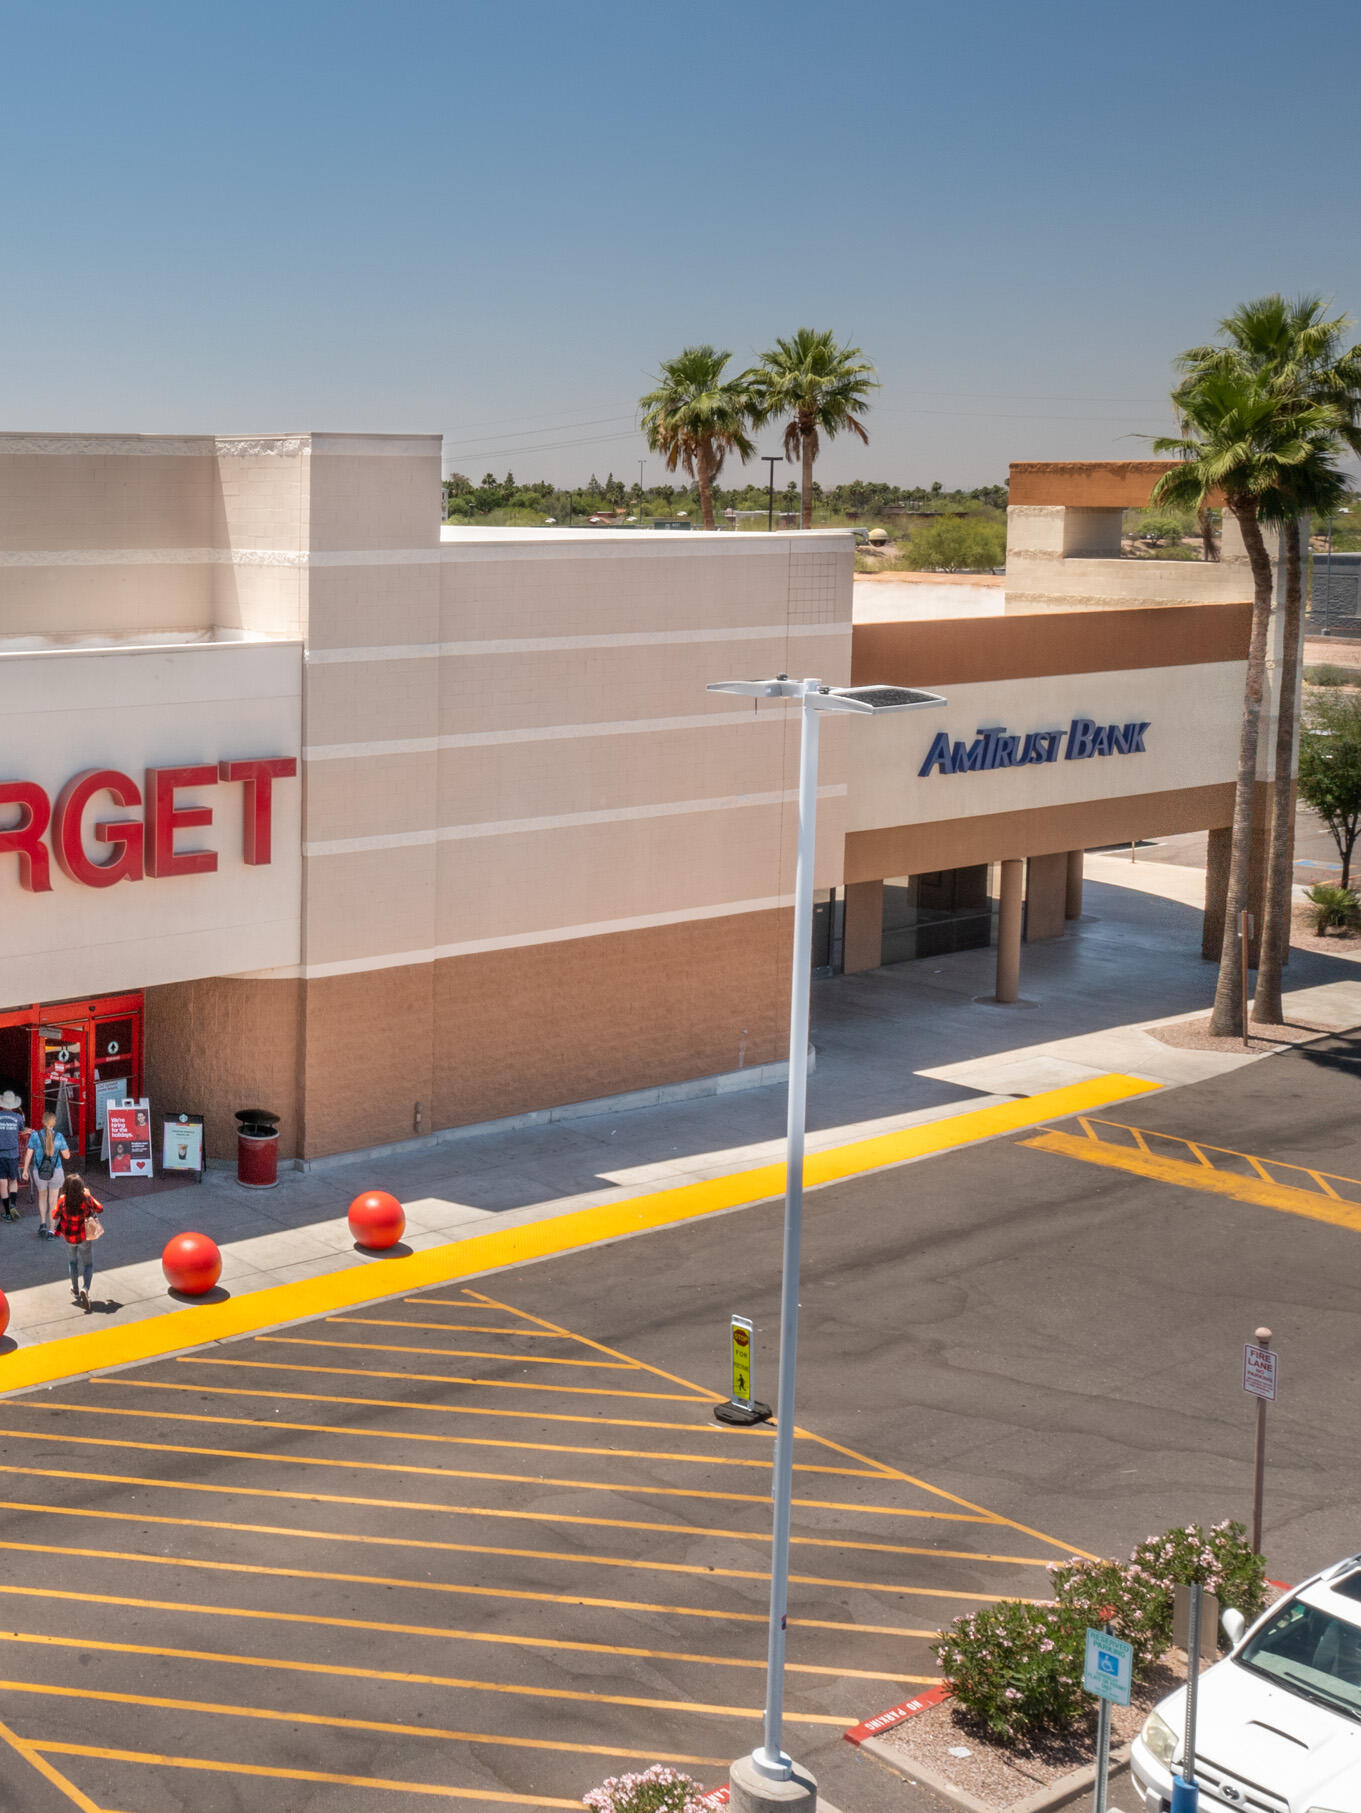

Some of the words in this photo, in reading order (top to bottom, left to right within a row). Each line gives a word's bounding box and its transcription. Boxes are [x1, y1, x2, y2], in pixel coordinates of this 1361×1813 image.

[1064, 718, 1152, 760] BANK
[1248, 1358, 1272, 1372] LANE
[1251, 1350, 1271, 1363] FIRE
[1090, 1631, 1129, 1653] RESERVED
[1093, 1640, 1126, 1658] PARKING
[906, 1700, 923, 1711] NO
[864, 1708, 907, 1730] PARKING
